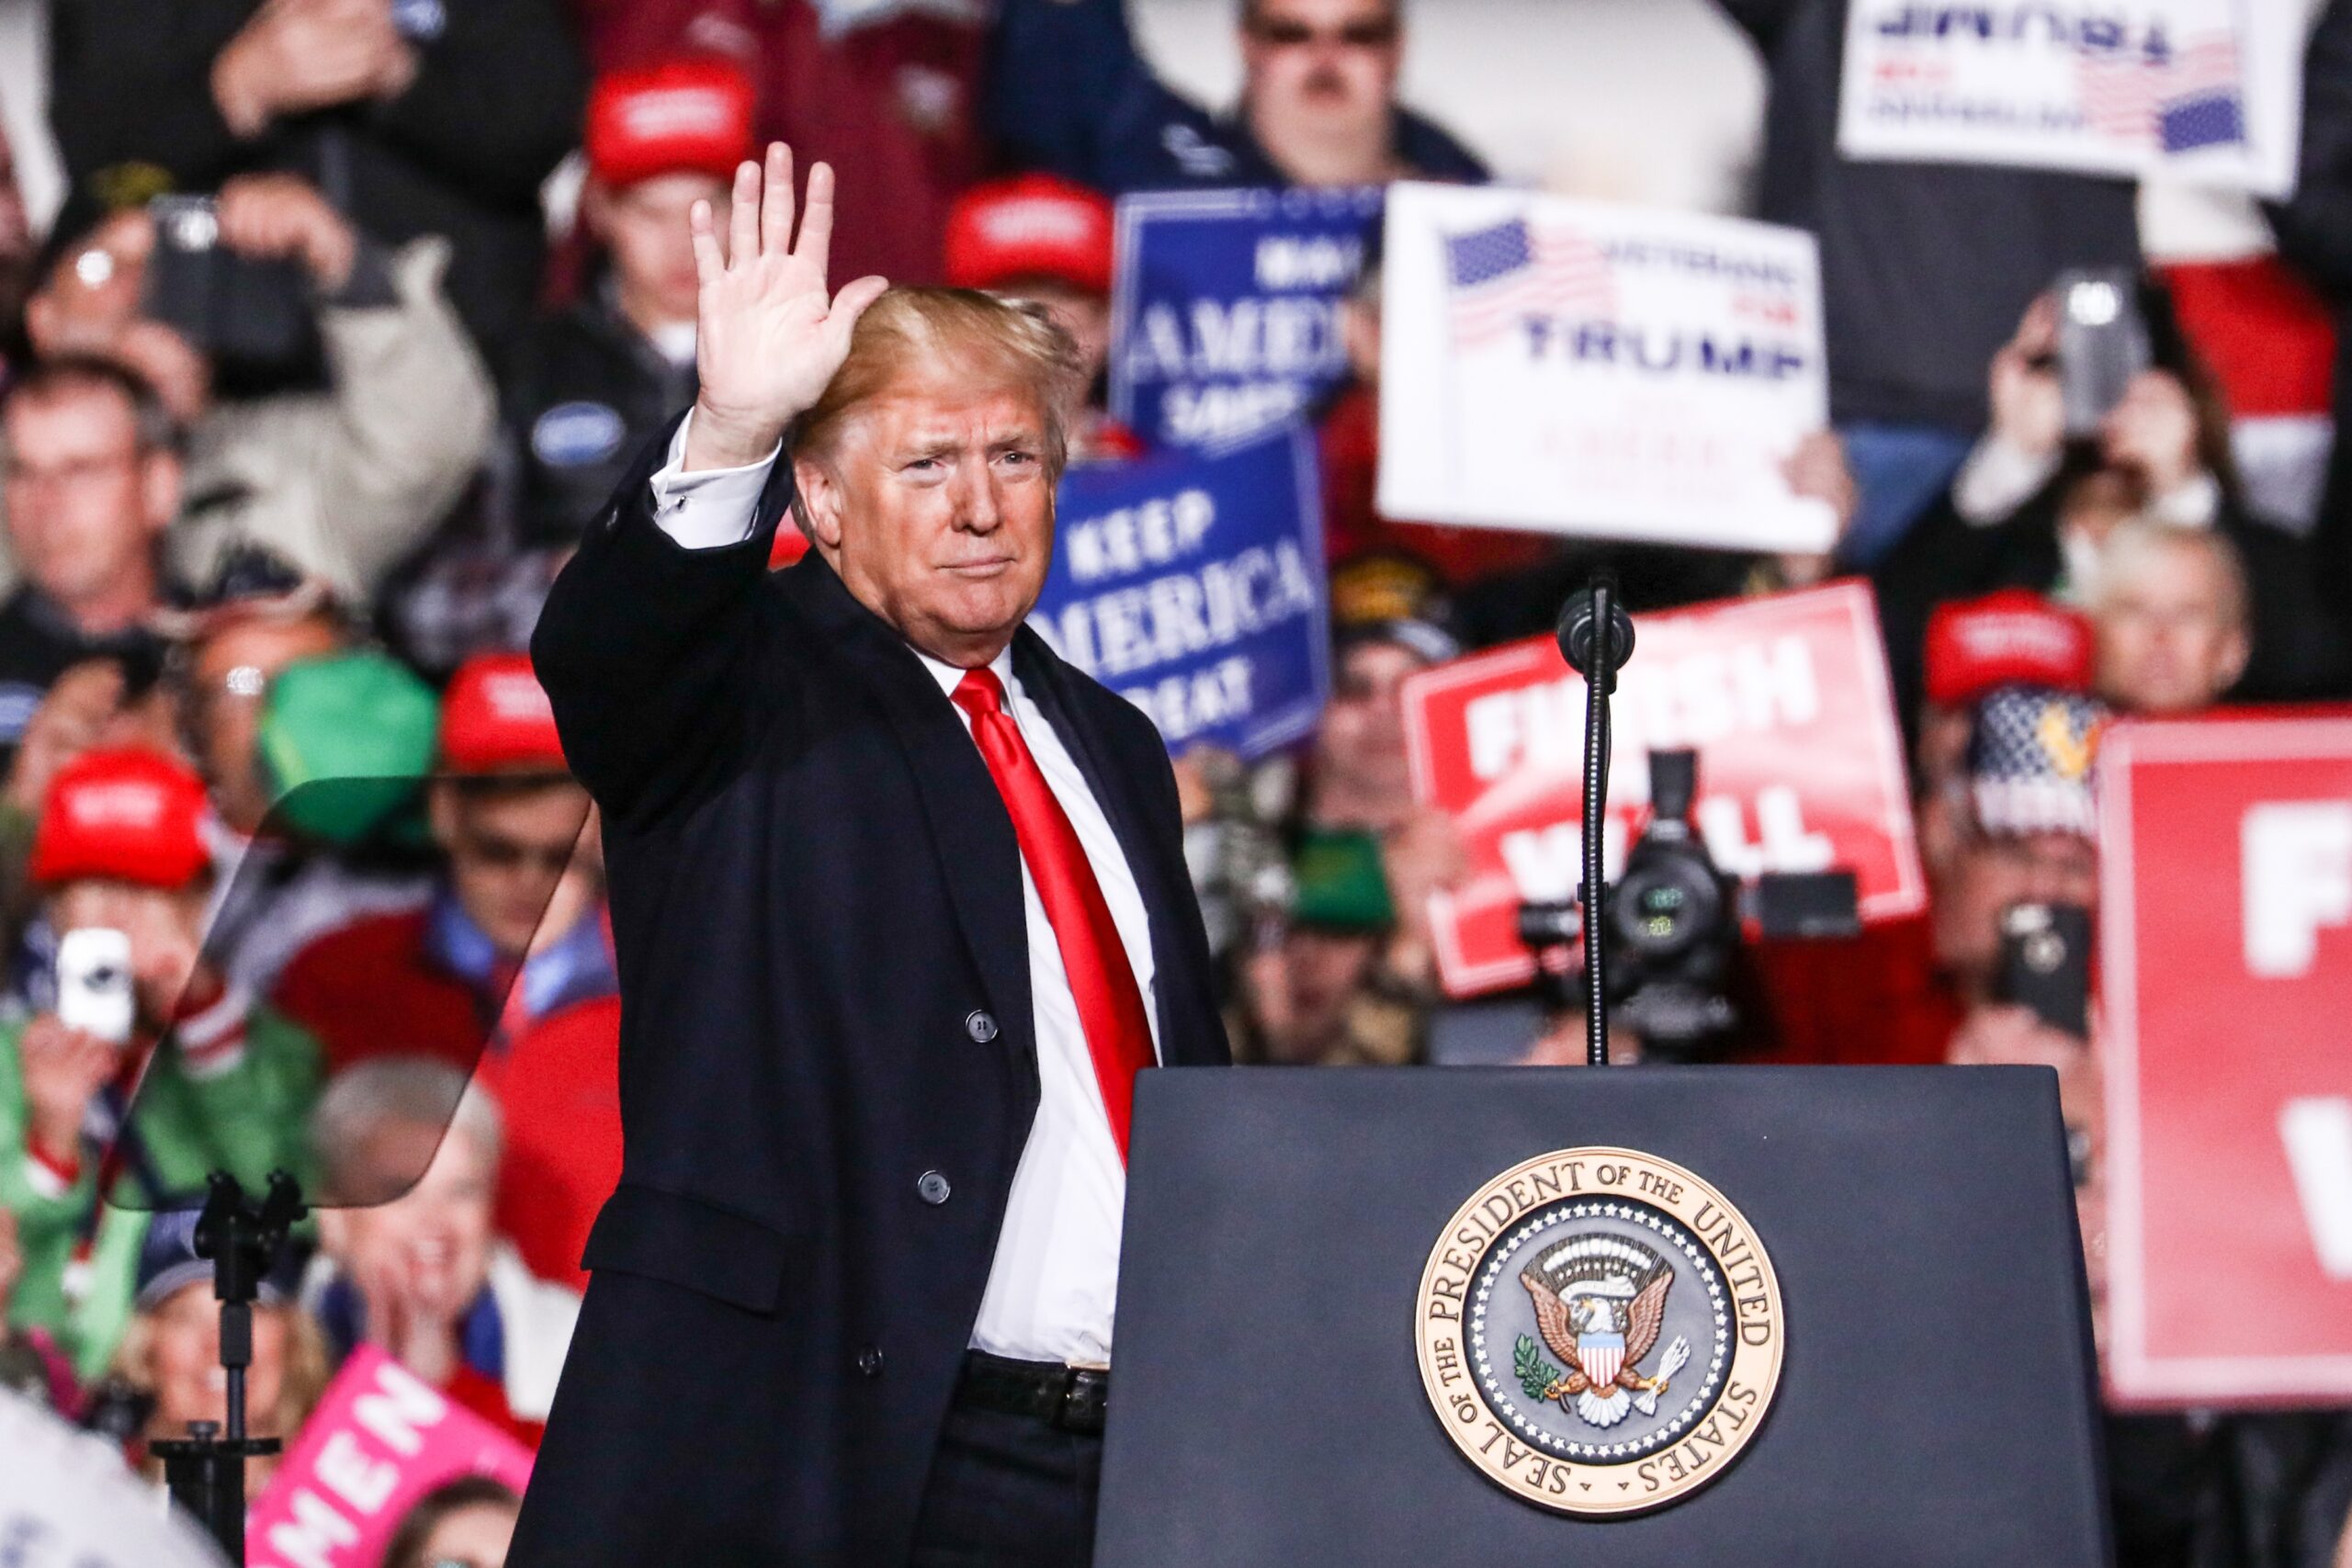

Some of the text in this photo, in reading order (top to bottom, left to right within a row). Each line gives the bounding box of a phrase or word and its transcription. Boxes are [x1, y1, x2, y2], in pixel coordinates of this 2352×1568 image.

[1522, 310, 1805, 383] TRUMP
[1066, 488, 1216, 585] KEEP
[1025, 535, 1316, 676] MERICA
[1498, 785, 1836, 904] WLL
[1429, 1161, 1771, 1495] SEAL OF THE PRESIDENT OF THE UNITED STATES
[265, 1359, 448, 1568] MEN
